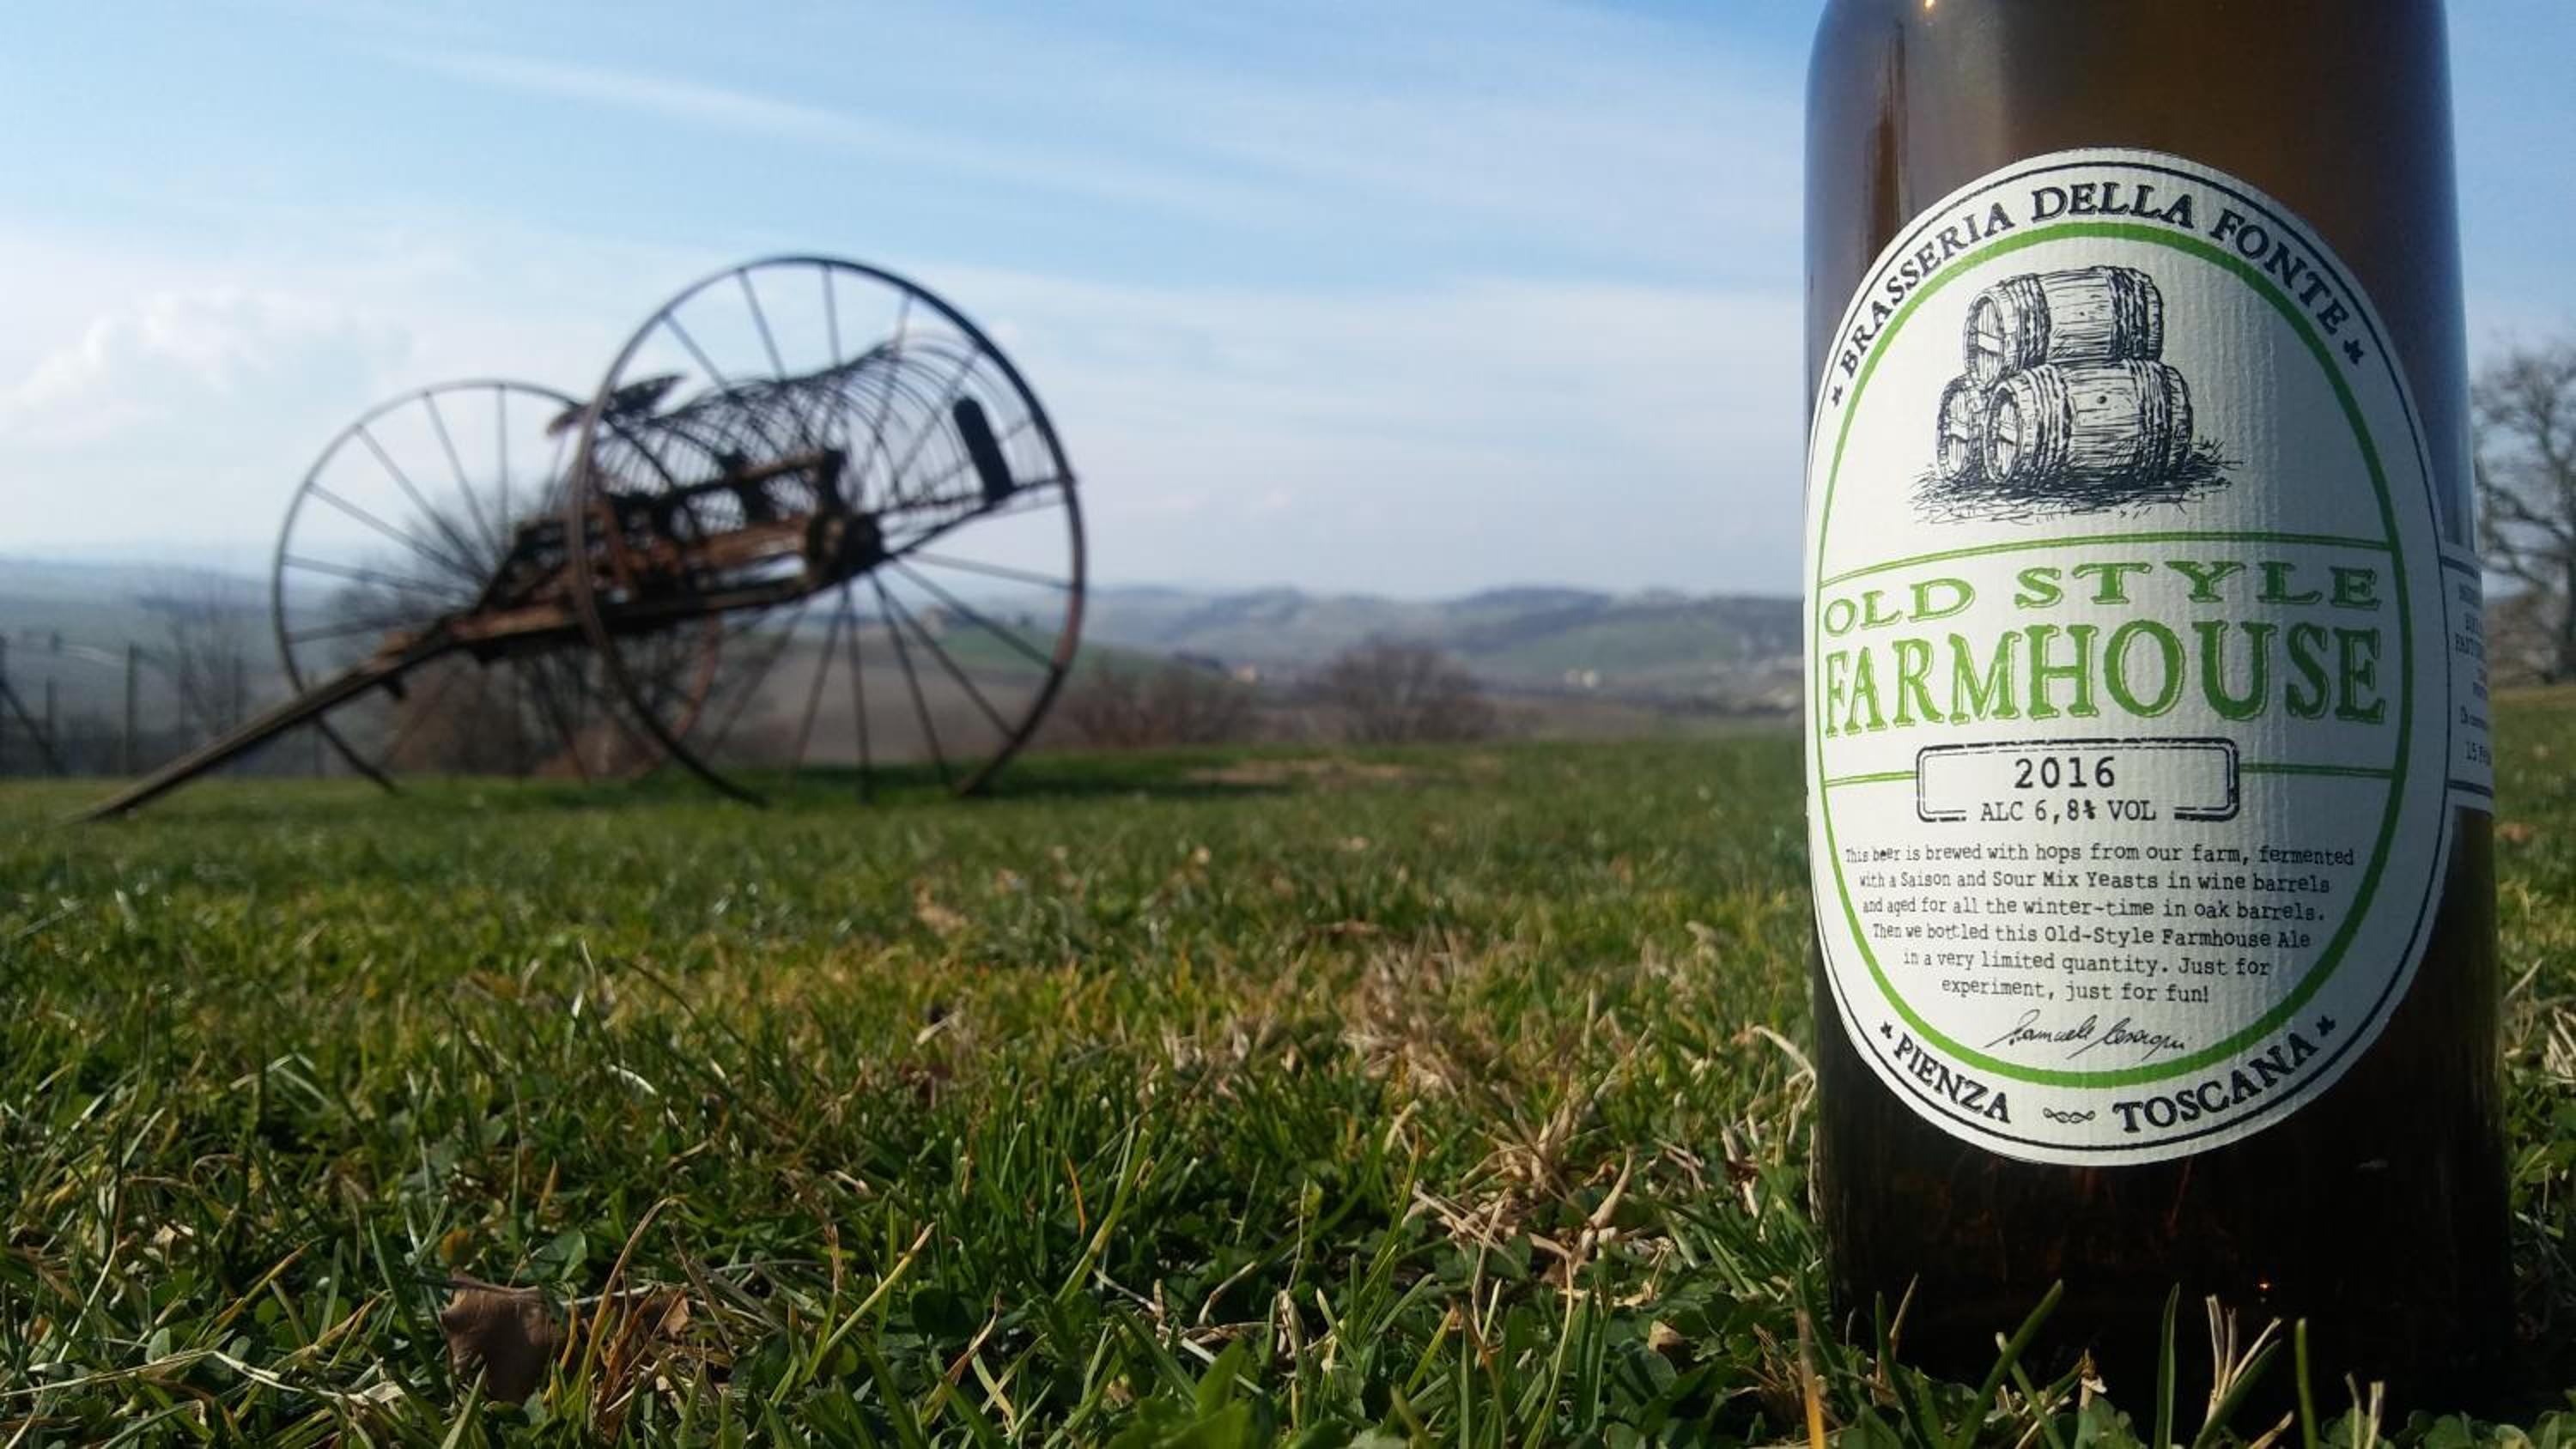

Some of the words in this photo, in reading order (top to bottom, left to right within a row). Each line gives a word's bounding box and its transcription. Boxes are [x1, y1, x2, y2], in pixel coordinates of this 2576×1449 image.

[1840, 202, 2015, 379] BRASSERIA
[2032, 182, 2195, 229] DELLA
[2209, 209, 2350, 336] FONTE
[1824, 577, 1976, 638] OLD
[2014, 561, 2383, 610] STYLE
[1825, 620, 2386, 738] FARMHOUSE
[2014, 755, 2116, 789] 2016
[1980, 799, 2023, 822] ALC
[2034, 799, 2097, 825] 6,8%
[2107, 799, 2157, 822] VOL
[1846, 848, 1868, 863] This
[1873, 848, 1900, 862] beer
[1906, 846, 1921, 861] is
[1926, 844, 1981, 860] brewed
[1986, 844, 2028, 860] with
[2035, 843, 2081, 864] hops
[2090, 843, 2140, 860] from
[2147, 846, 2184, 860] our
[2192, 844, 2250, 865] farm,
[2258, 845, 2354, 866] fermented
[1860, 871, 1885, 888] with
[1889, 875, 1896, 888] a
[1900, 871, 1951, 888] Saison
[1957, 870, 1986, 887] and
[1992, 871, 2036, 887] Sour
[2043, 870, 2080, 887] Mix
[2086, 871, 2158, 889] Yeasts
[2168, 871, 2191, 889] in
[2198, 872, 2246, 890] wine
[2252, 872, 2330, 894] barrels
[1862, 897, 1883, 914] and
[1886, 897, 1916, 917] aged
[1921, 896, 1947, 913] for
[1953, 897, 1981, 914] all
[1986, 898, 2017, 914] the
[2023, 898, 2154, 916] winter-time
[2162, 898, 2187, 918] in
[2194, 900, 2231, 919] oak
[2237, 900, 2325, 921] barrels.
[1873, 923, 1902, 939] Then
[1905, 925, 1922, 938] we
[1926, 923, 1988, 940] bottled
[1996, 925, 2038, 942] this
[2044, 925, 2154, 948] Old-Style
[2162, 928, 2271, 948] Farmhouse
[2277, 931, 2311, 949] Ale
[1903, 950, 1919, 965] in
[1923, 953, 1932, 966] a
[1938, 953, 1975, 970] very
[1981, 950, 2055, 969] limited
[2062, 953, 2168, 976] quantity.
[2178, 957, 2227, 976] Just
[2235, 956, 2270, 976] for
[1941, 979, 2055, 1000] experiment,
[2065, 981, 2112, 1001] just
[2121, 984, 2159, 1001] for
[2166, 984, 2208, 1003] fun!
[1893, 1034, 2011, 1124] PIENZA
[2112, 1034, 2319, 1134] TOSCANA
